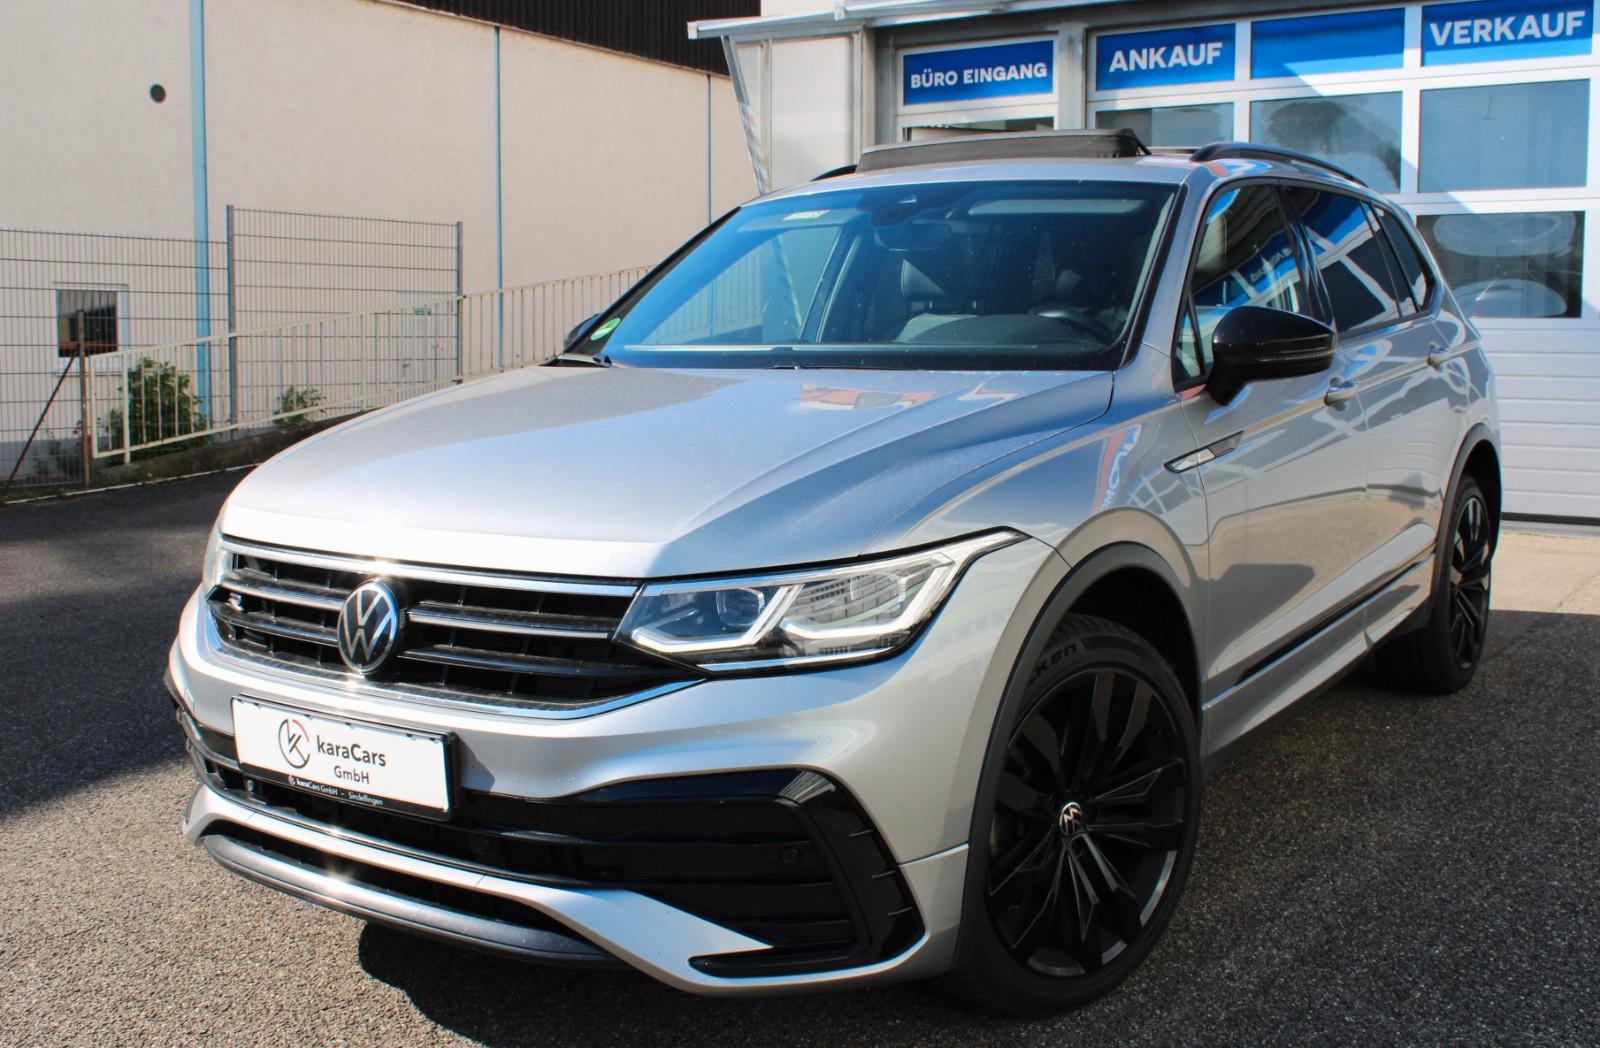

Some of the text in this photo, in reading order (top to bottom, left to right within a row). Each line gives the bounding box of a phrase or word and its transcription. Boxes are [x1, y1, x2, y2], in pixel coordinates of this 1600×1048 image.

[1429, 10, 1585, 46] VERKAUF
[1109, 42, 1223, 73] ANKAUF
[910, 62, 1048, 89] BÜRO EINGANG
[316, 734, 386, 767] karaCars
[296, 778, 320, 791] karaCars
[320, 784, 338, 796] GmbH
[334, 765, 370, 784] GmbH
